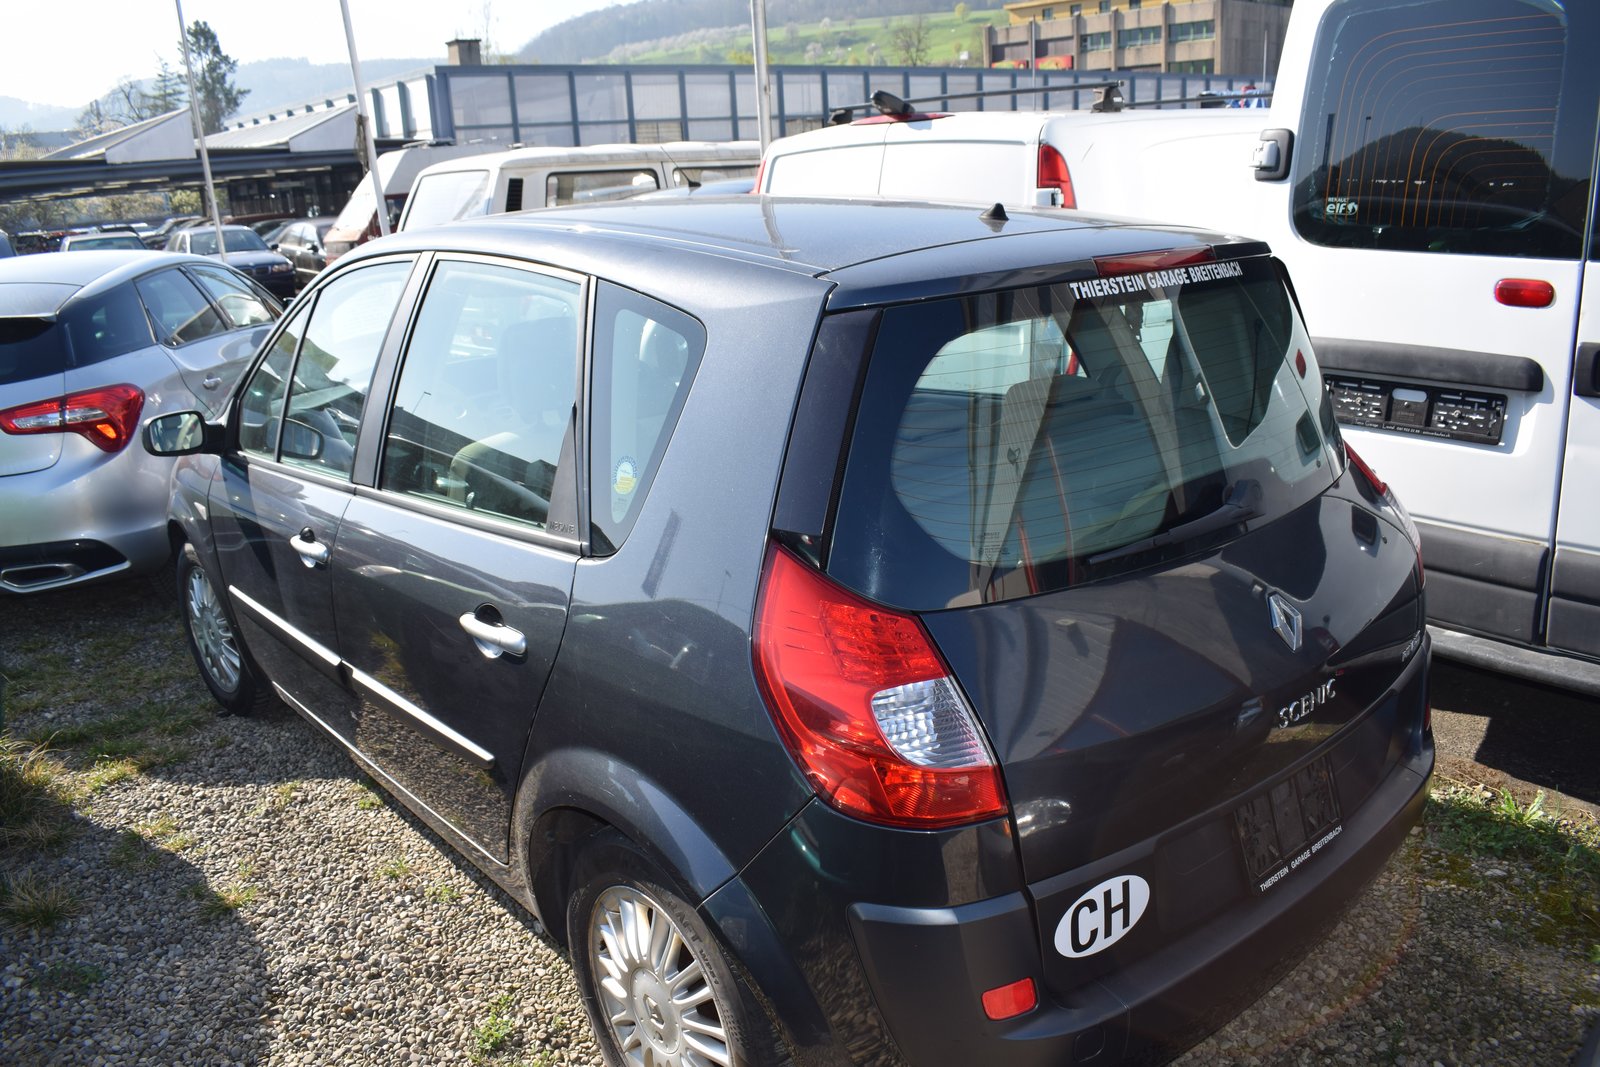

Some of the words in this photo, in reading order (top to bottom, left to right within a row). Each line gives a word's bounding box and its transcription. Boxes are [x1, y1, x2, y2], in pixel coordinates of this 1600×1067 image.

[1069, 274, 1146, 300] THIERSTEIN
[1146, 267, 1190, 289] GARAGE
[1190, 261, 1243, 283] BREITENBACH
[1279, 678, 1337, 729] SCENIC
[1259, 866, 1289, 892] THIERSTEIN
[1290, 849, 1311, 869] GARAGE
[1311, 825, 1343, 853] BREITENBACH
[1070, 879, 1130, 953] CH
